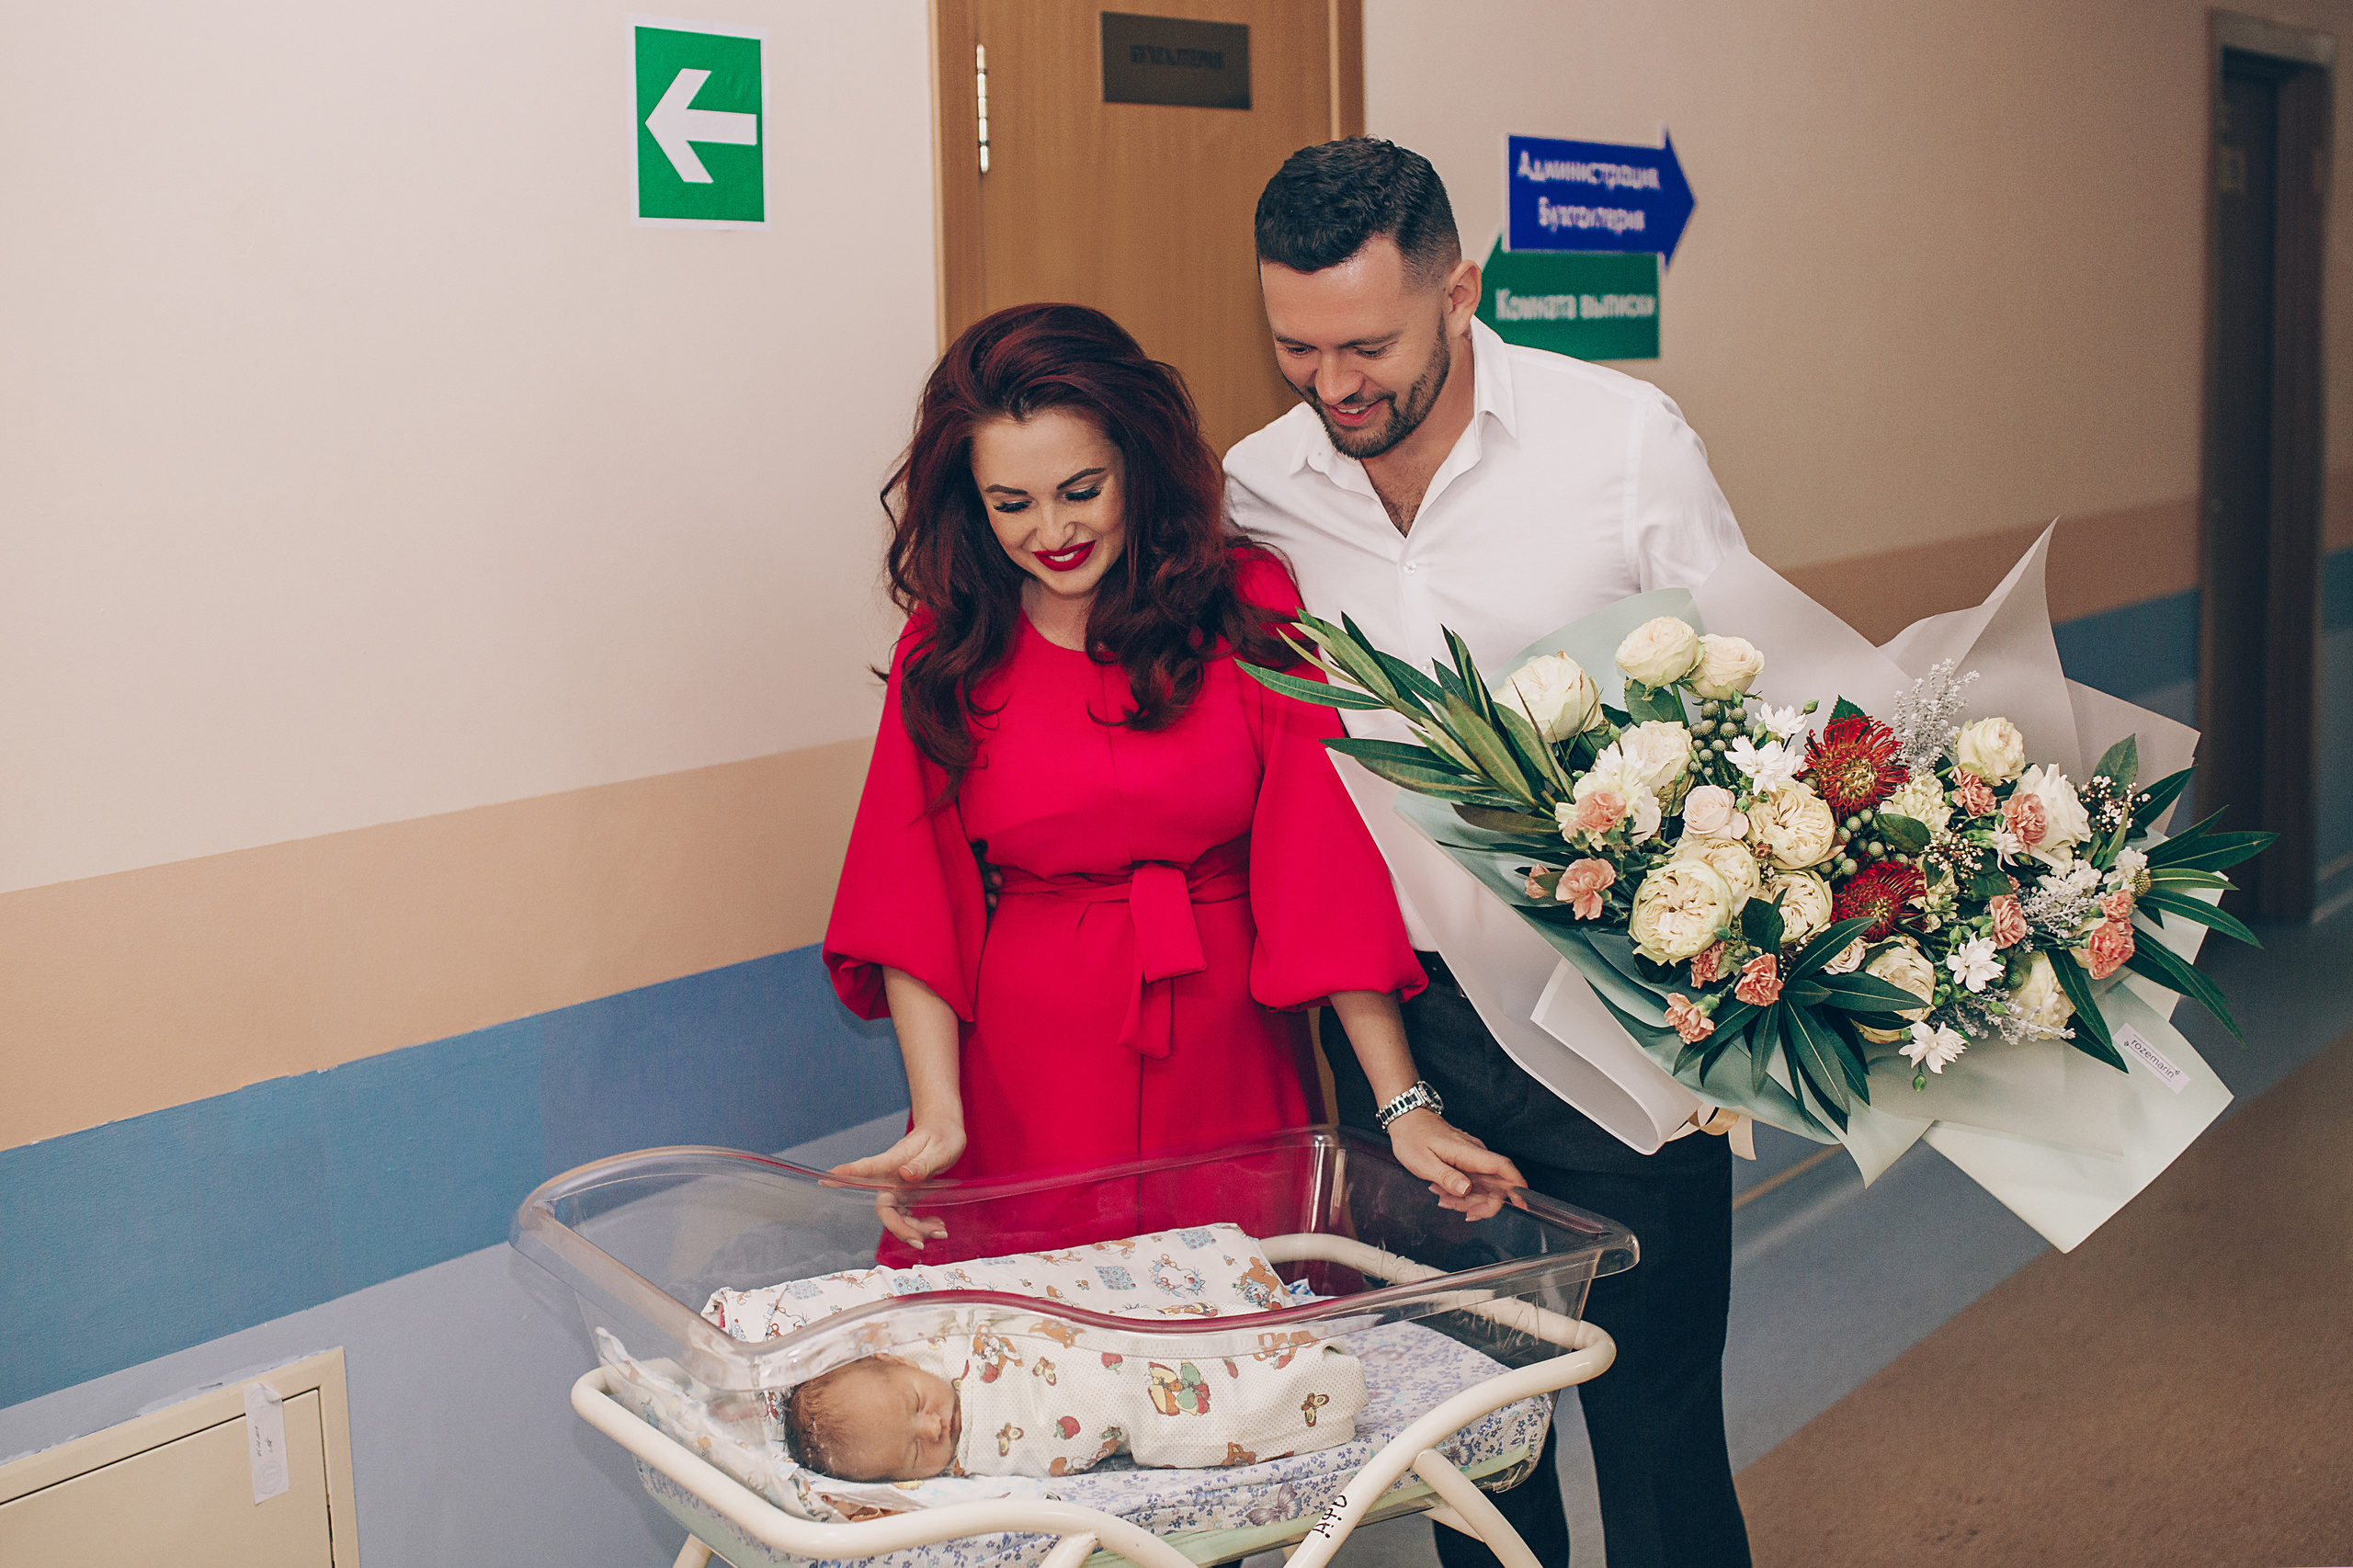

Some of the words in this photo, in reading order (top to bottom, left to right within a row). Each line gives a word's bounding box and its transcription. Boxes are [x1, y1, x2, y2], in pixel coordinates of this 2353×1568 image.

[1518, 150, 1660, 191] Администрация
[1539, 196, 1645, 234] Бухгалтерия
[1495, 287, 1576, 320] Комната
[1579, 293, 1655, 319] выписки
[2131, 1040, 2175, 1079] rozemarin
